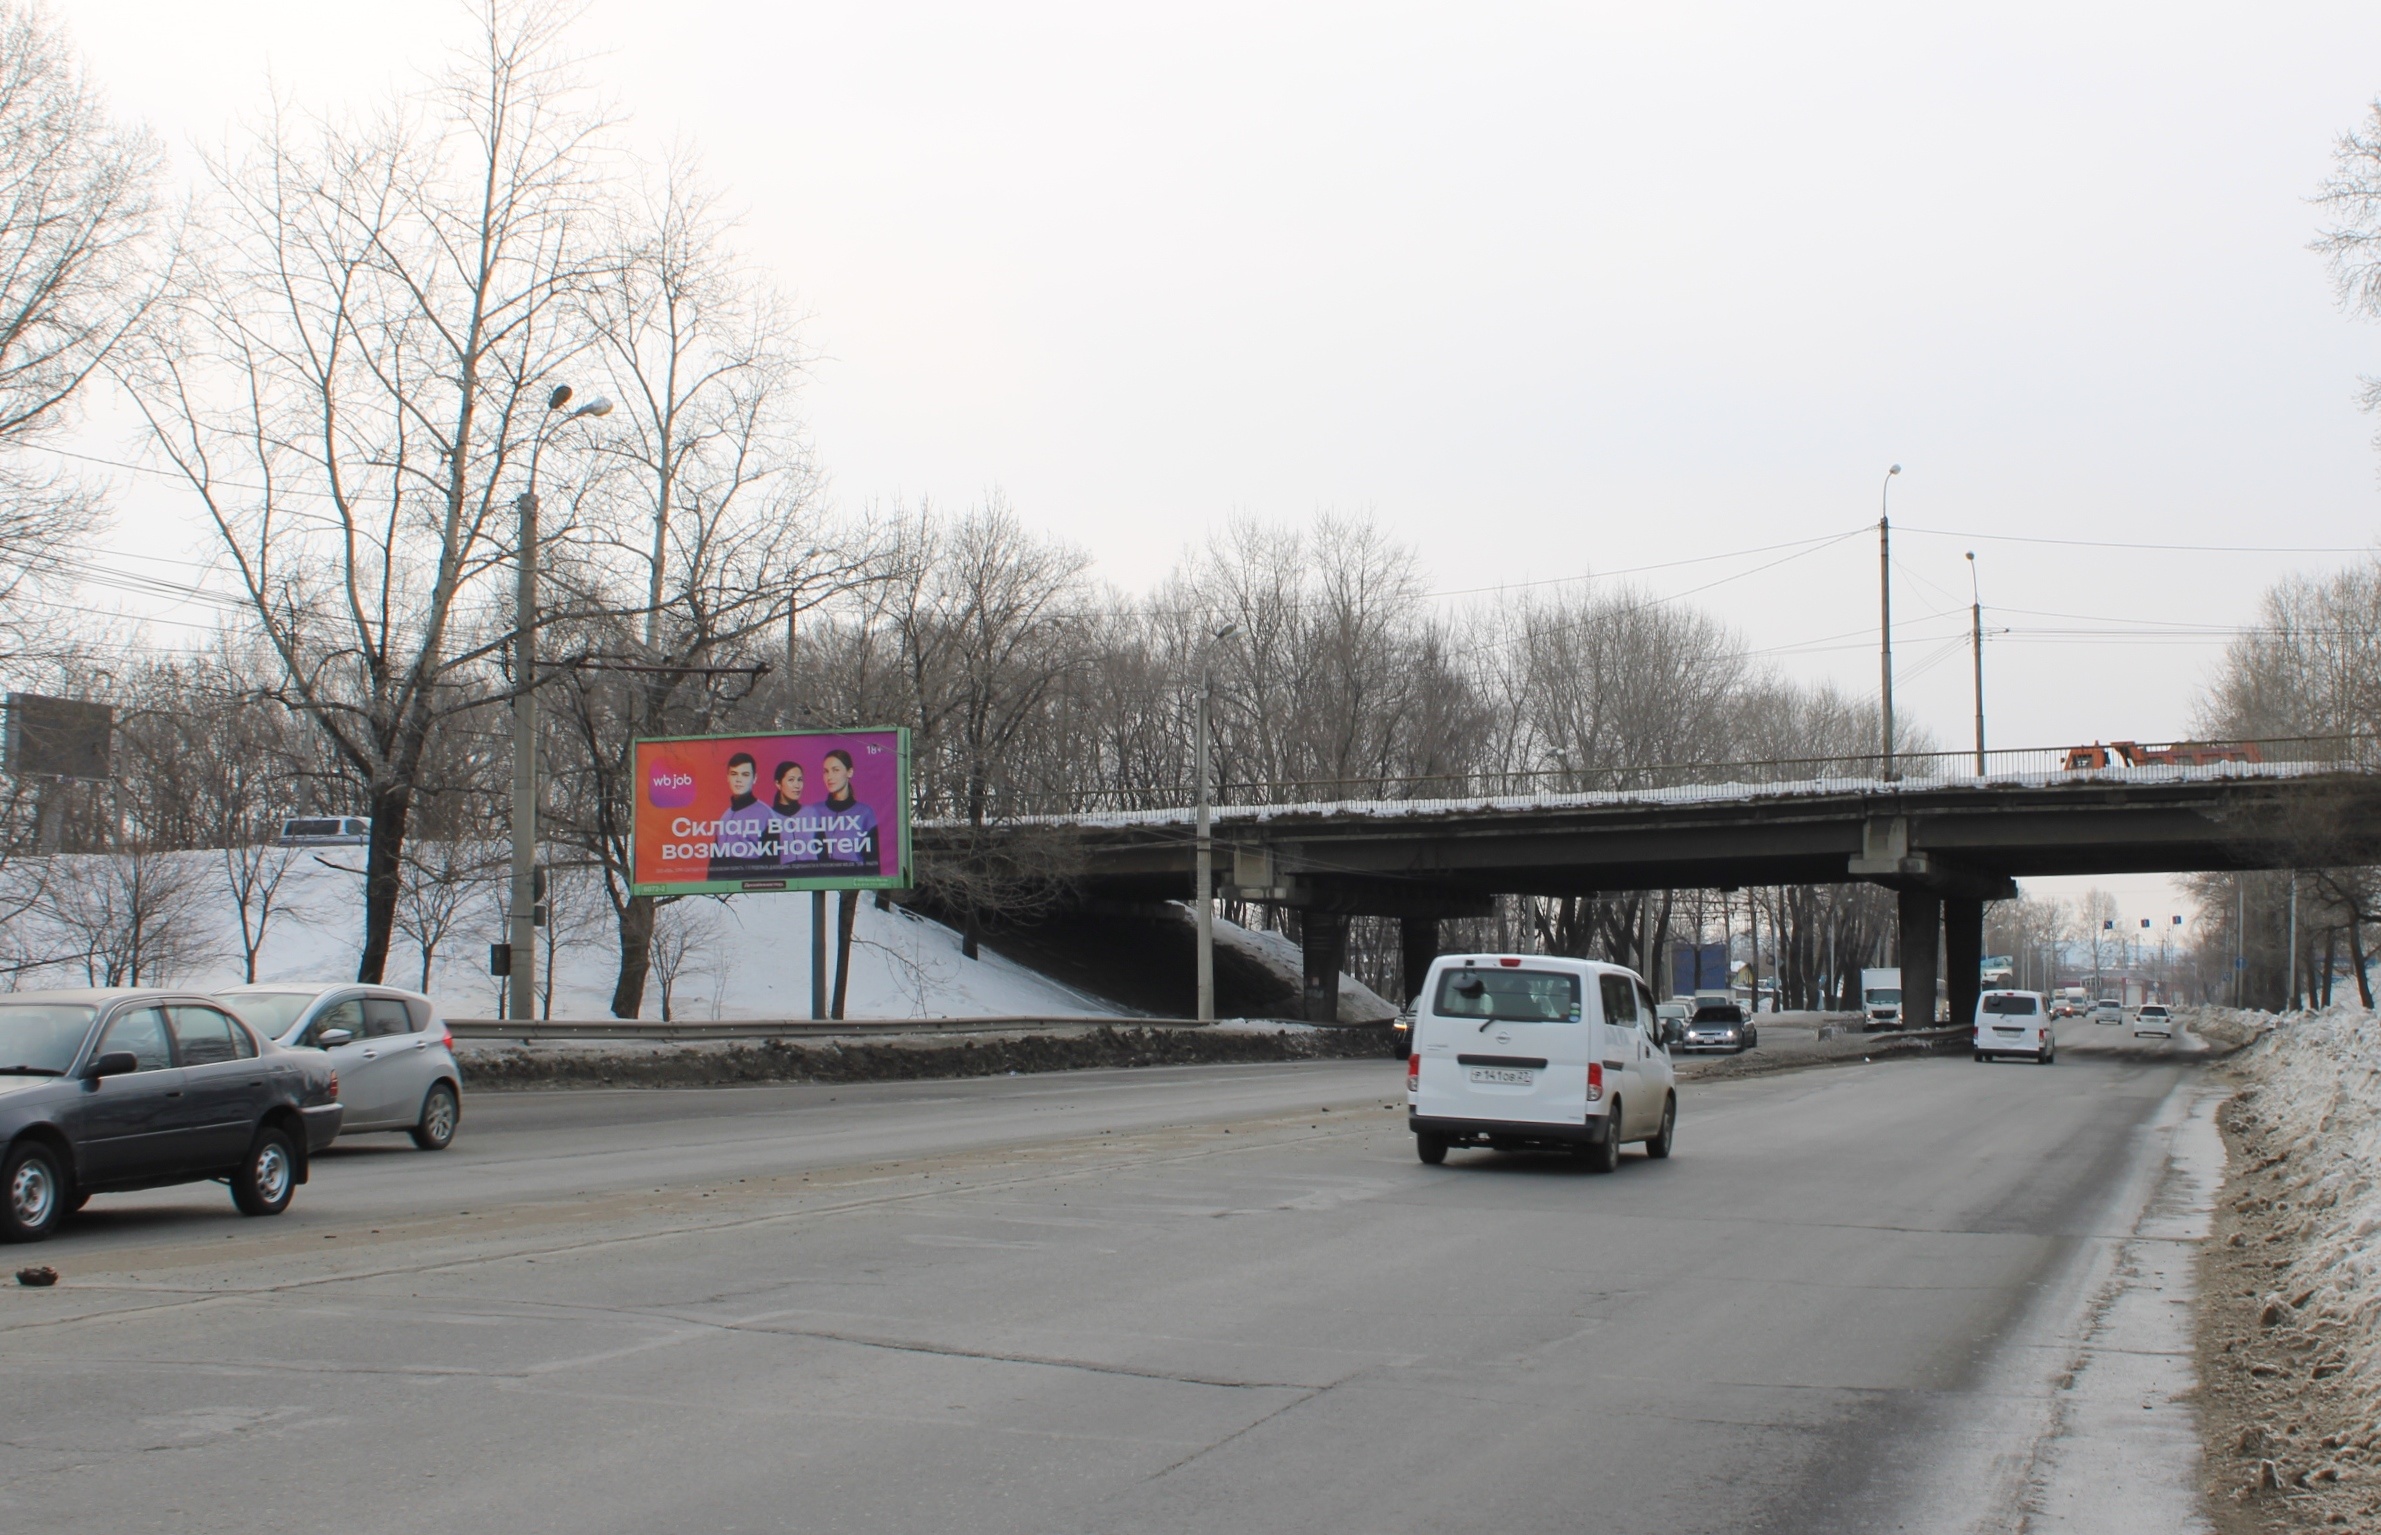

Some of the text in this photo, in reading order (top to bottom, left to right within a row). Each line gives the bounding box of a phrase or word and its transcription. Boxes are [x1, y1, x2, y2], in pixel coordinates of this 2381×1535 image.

[653, 773, 692, 789] wb job
[671, 815, 861, 838] Склад ваших
[662, 831, 872, 860] возможностей
